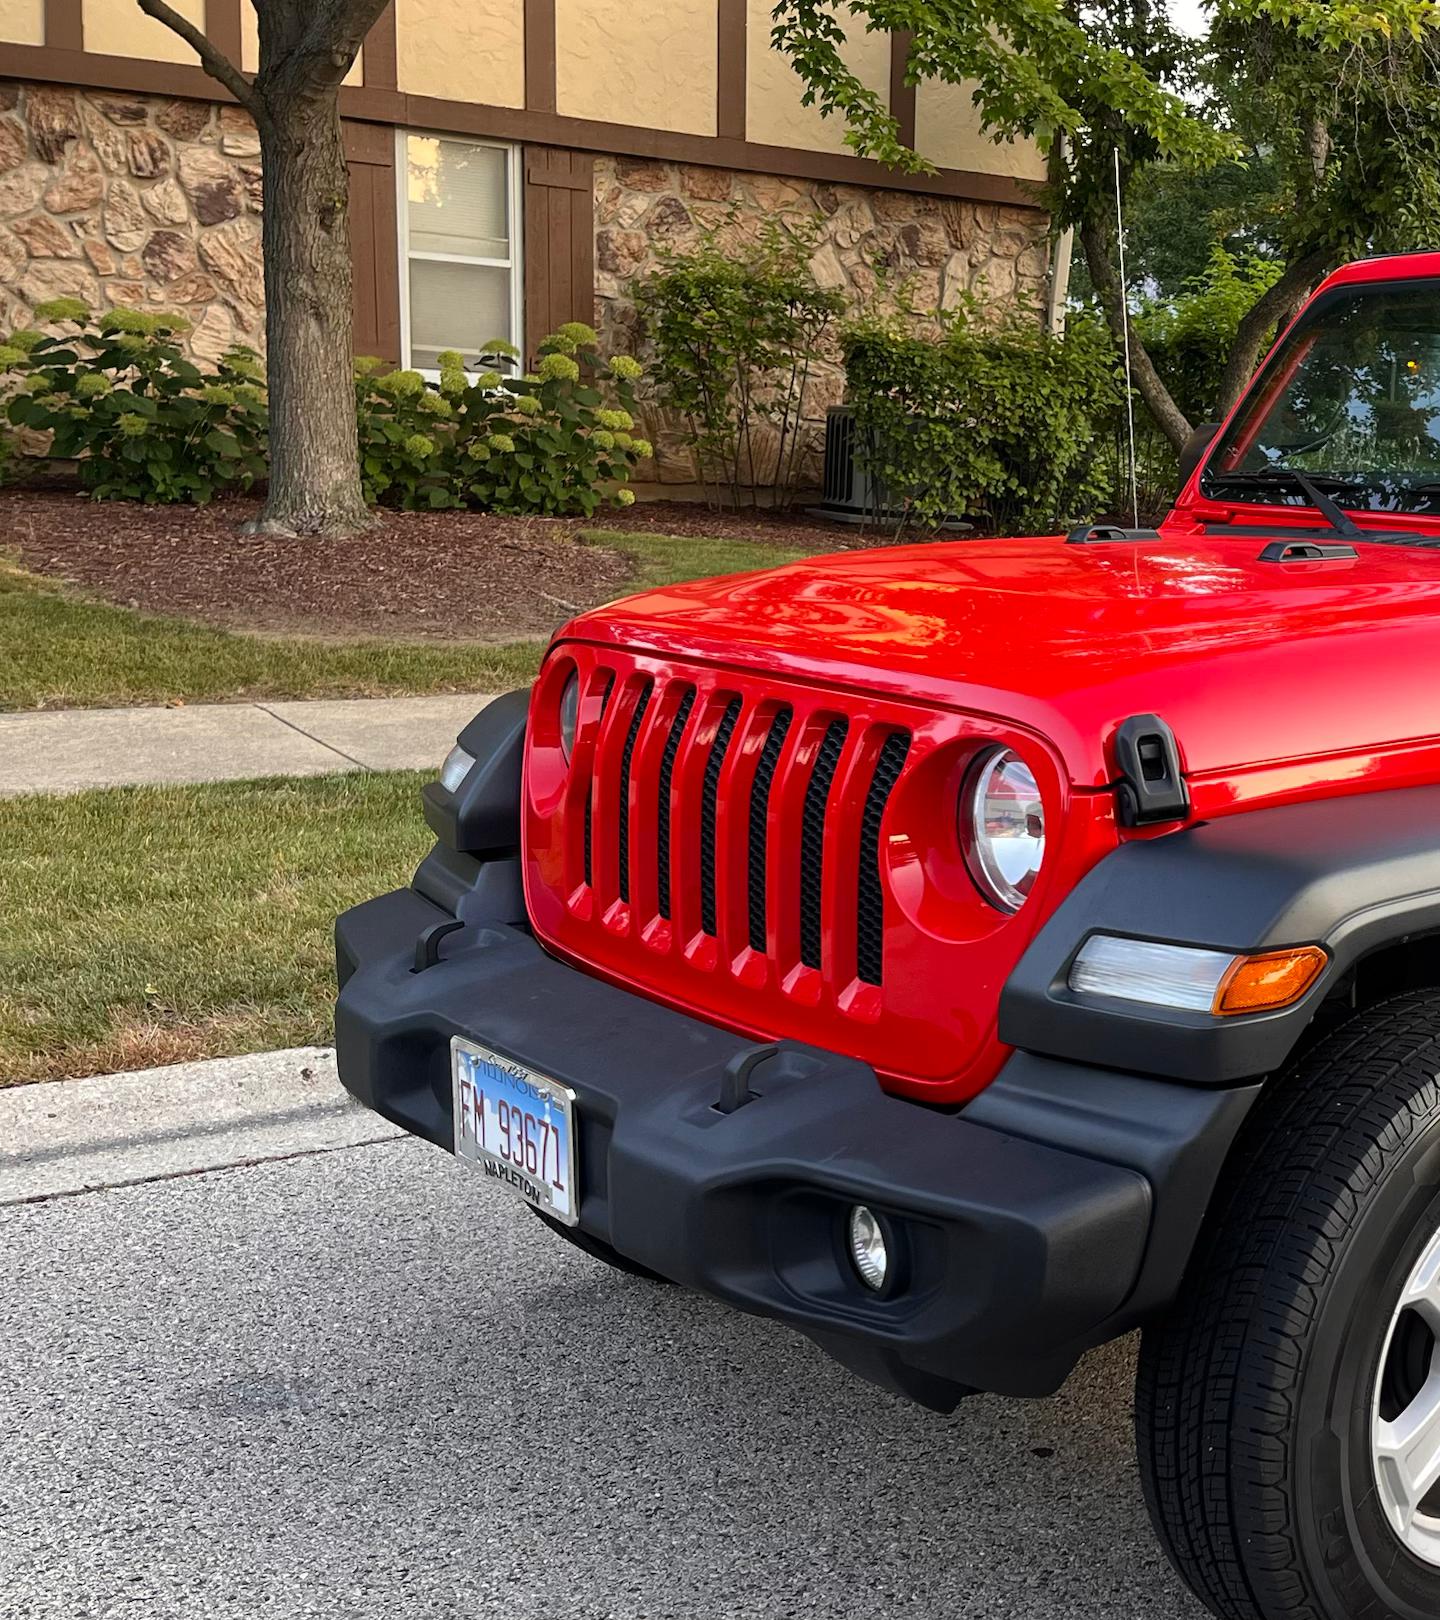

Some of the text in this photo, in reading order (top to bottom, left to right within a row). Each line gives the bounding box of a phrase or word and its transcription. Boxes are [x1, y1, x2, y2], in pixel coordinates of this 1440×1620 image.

[483, 1061, 541, 1101] ILLINOIS
[460, 1079, 565, 1192] FM 93671
[483, 1159, 541, 1205] NAPLETON
